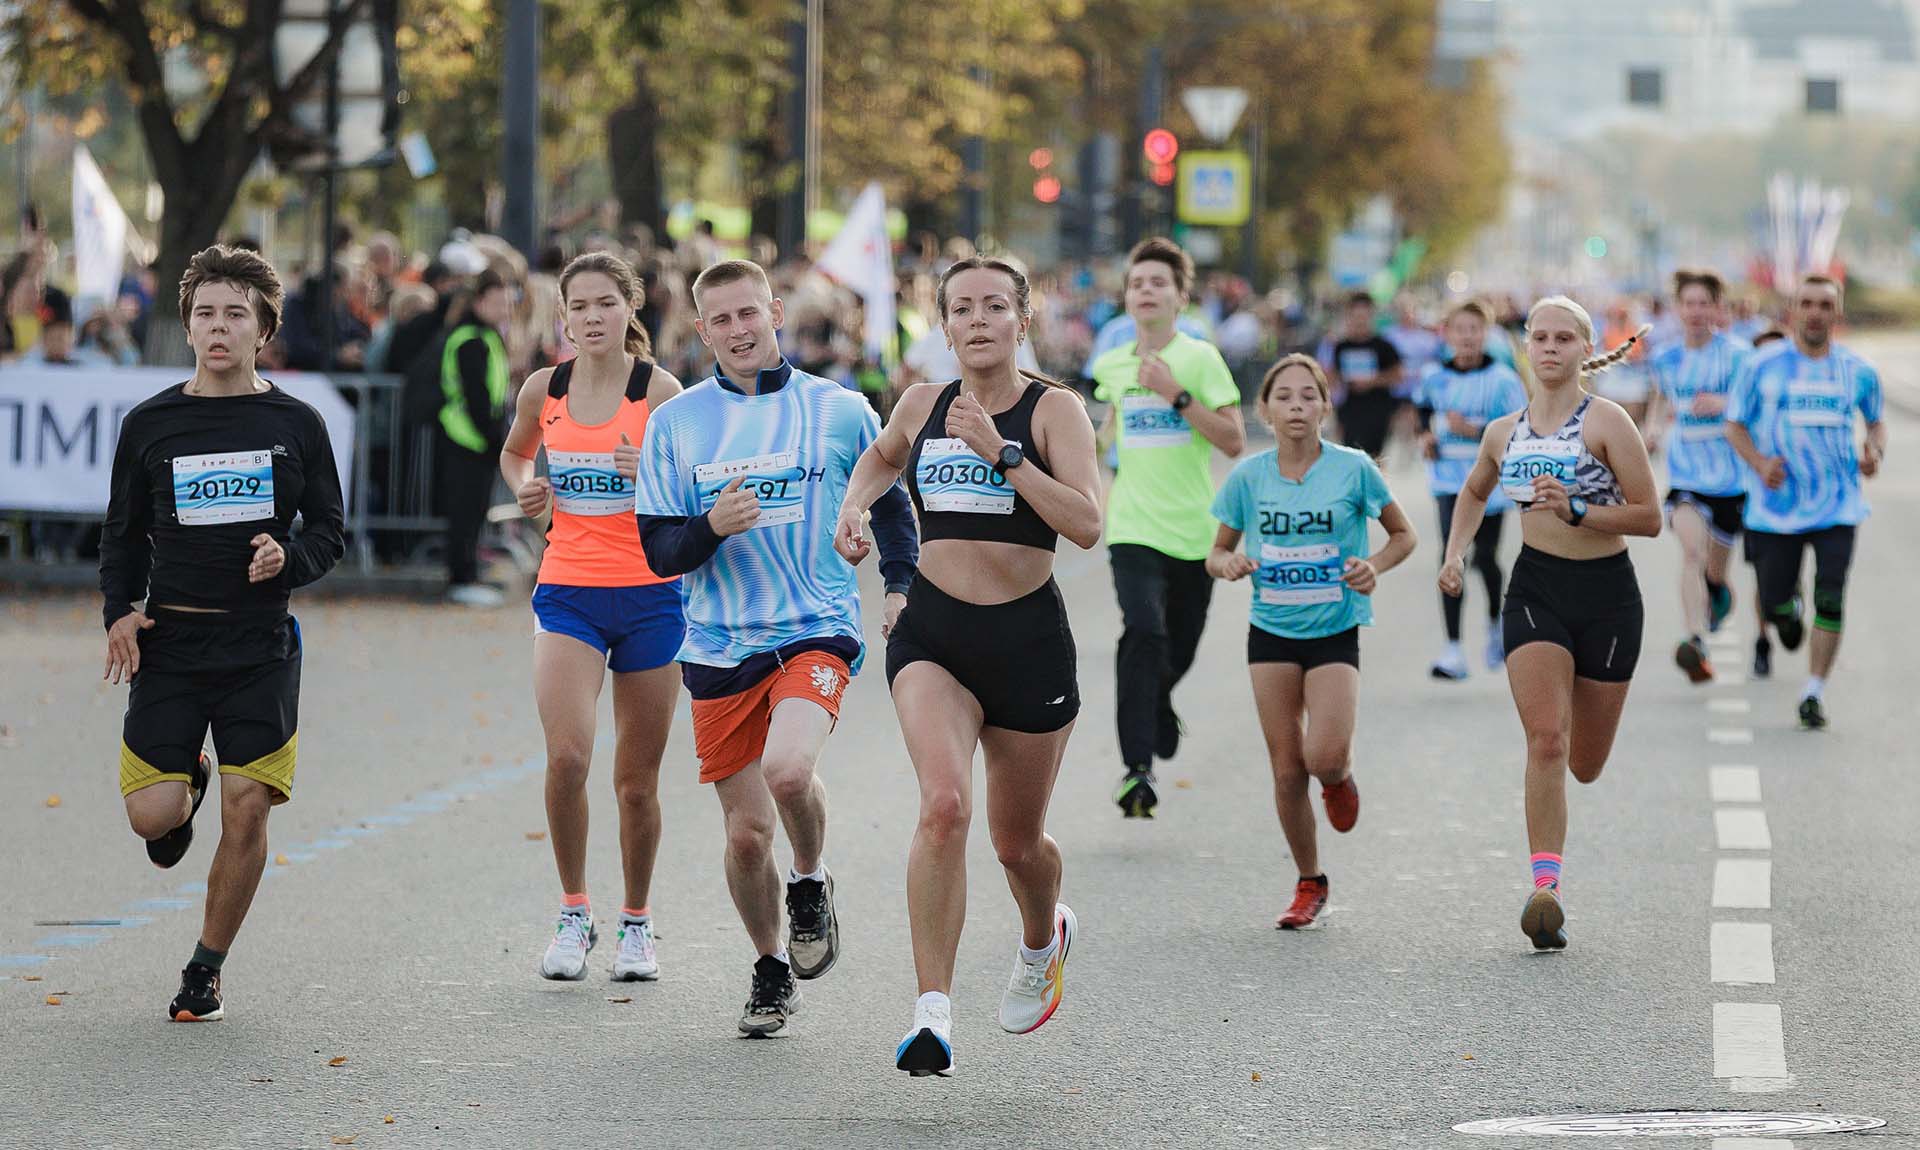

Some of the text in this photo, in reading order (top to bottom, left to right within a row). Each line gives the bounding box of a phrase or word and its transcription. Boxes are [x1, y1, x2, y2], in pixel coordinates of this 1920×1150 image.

[923, 464, 1006, 487] 20300
[1510, 462, 1565, 479] 21082
[187, 476, 261, 500] 20129
[558, 474, 625, 493] 20158
[1259, 510, 1333, 535] 20:24
[1265, 565, 1330, 584] 21003
